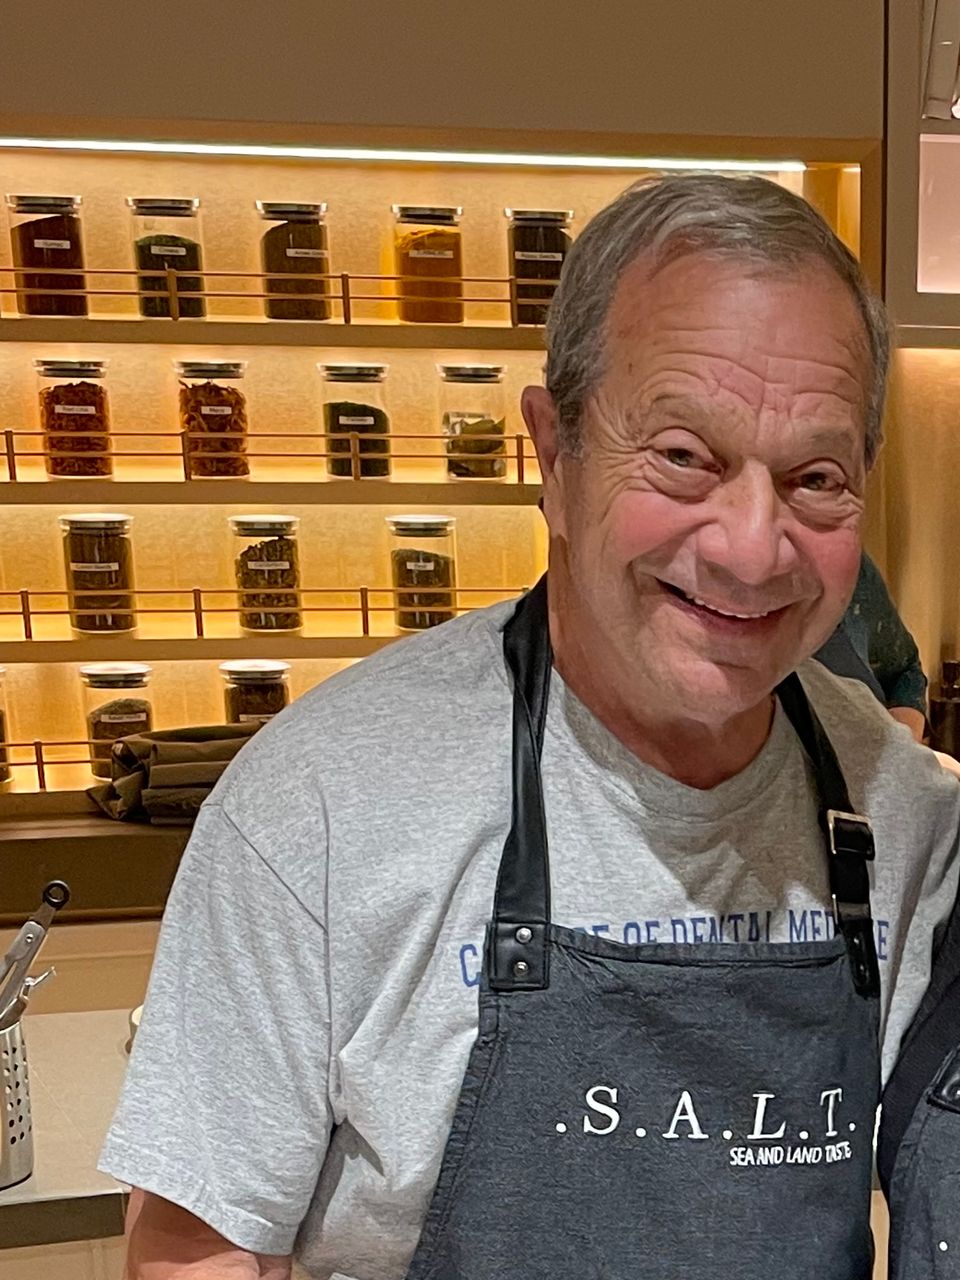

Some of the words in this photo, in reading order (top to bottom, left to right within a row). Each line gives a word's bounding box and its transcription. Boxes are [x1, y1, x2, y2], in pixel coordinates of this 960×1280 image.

[729, 1146, 755, 1166] SEA
[756, 1146, 784, 1166] AND
[786, 1146, 822, 1164] LAND
